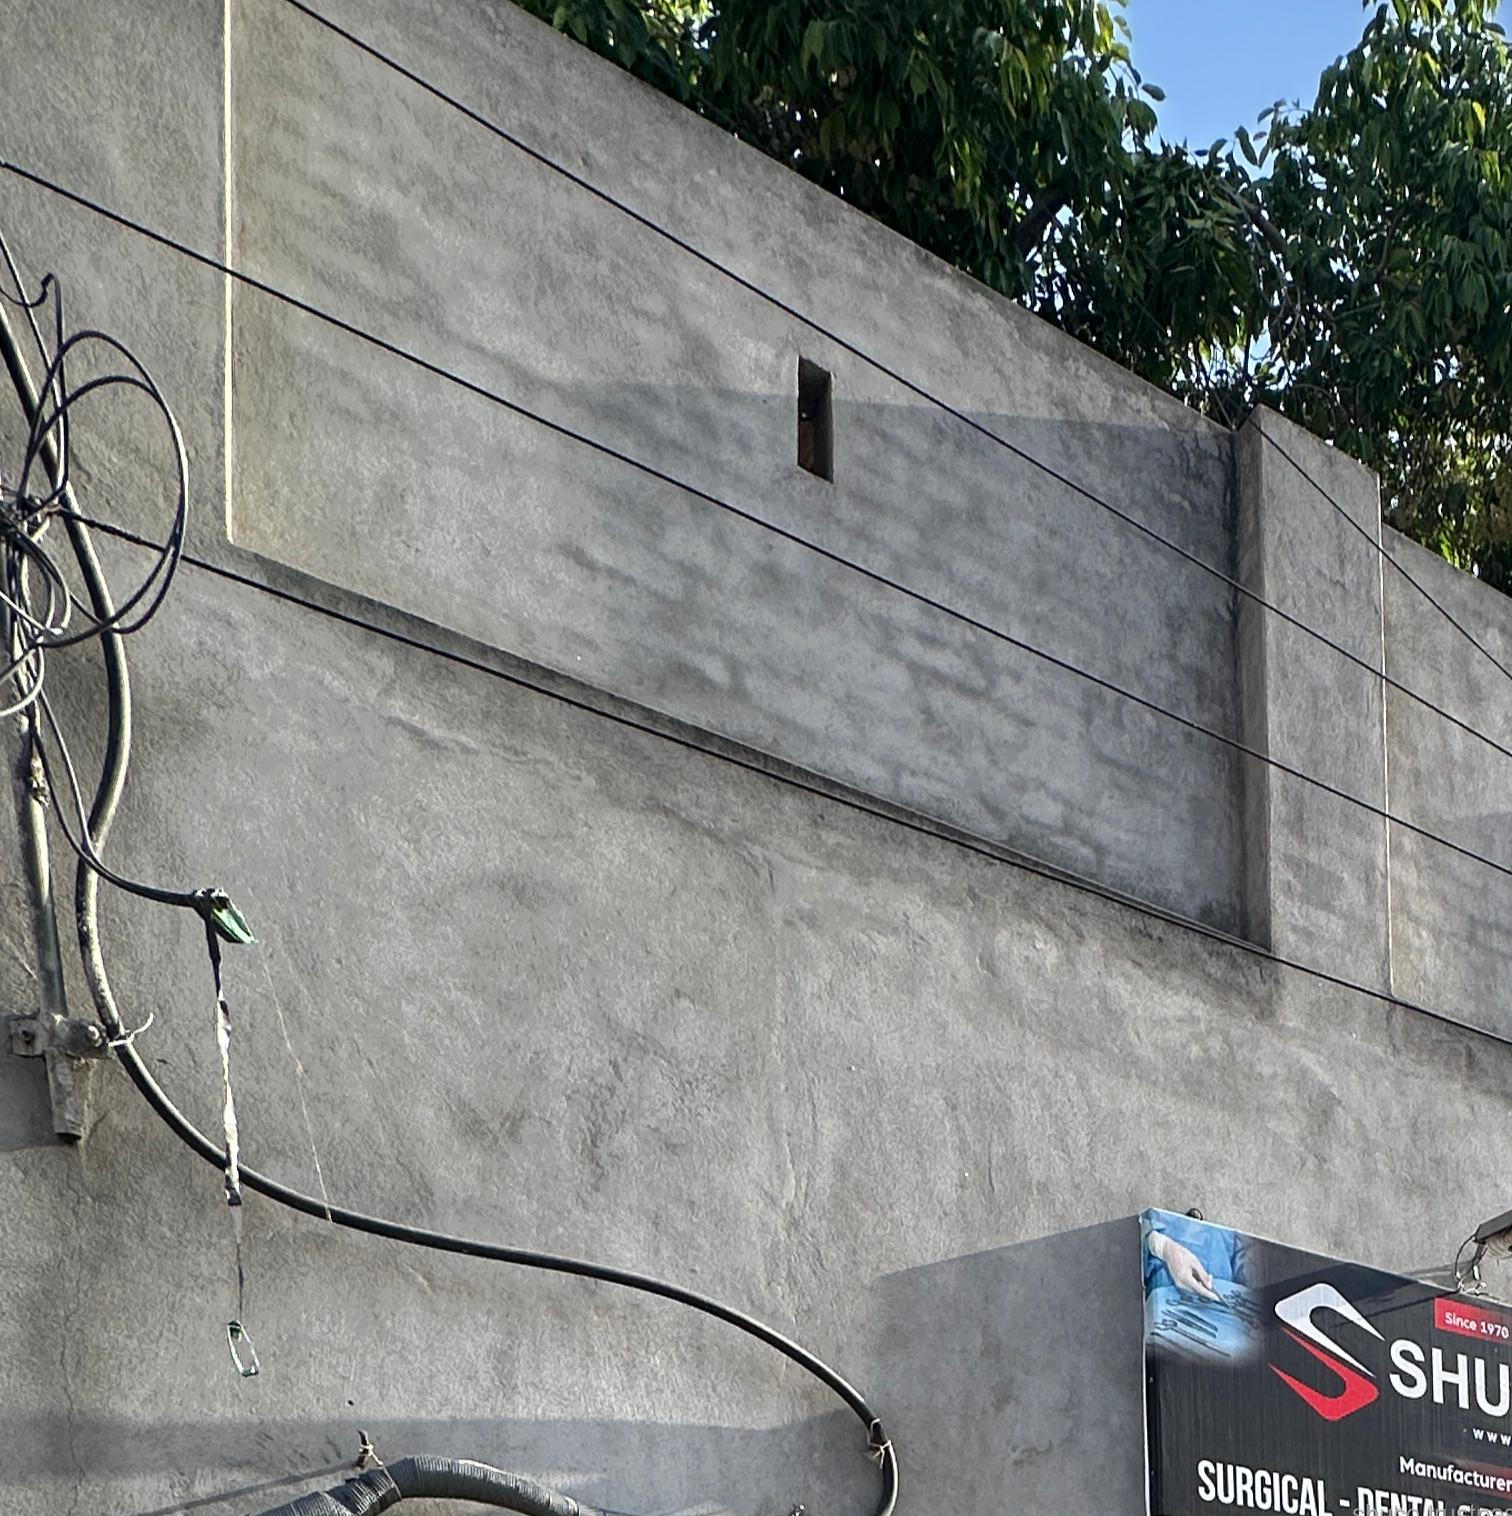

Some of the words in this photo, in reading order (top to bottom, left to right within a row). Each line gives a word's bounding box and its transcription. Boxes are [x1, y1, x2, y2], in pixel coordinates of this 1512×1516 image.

[1445, 1312, 1477, 1332] Since
[1480, 1320, 1510, 1339] 1970
[1389, 1339, 1510, 1418] SHU
